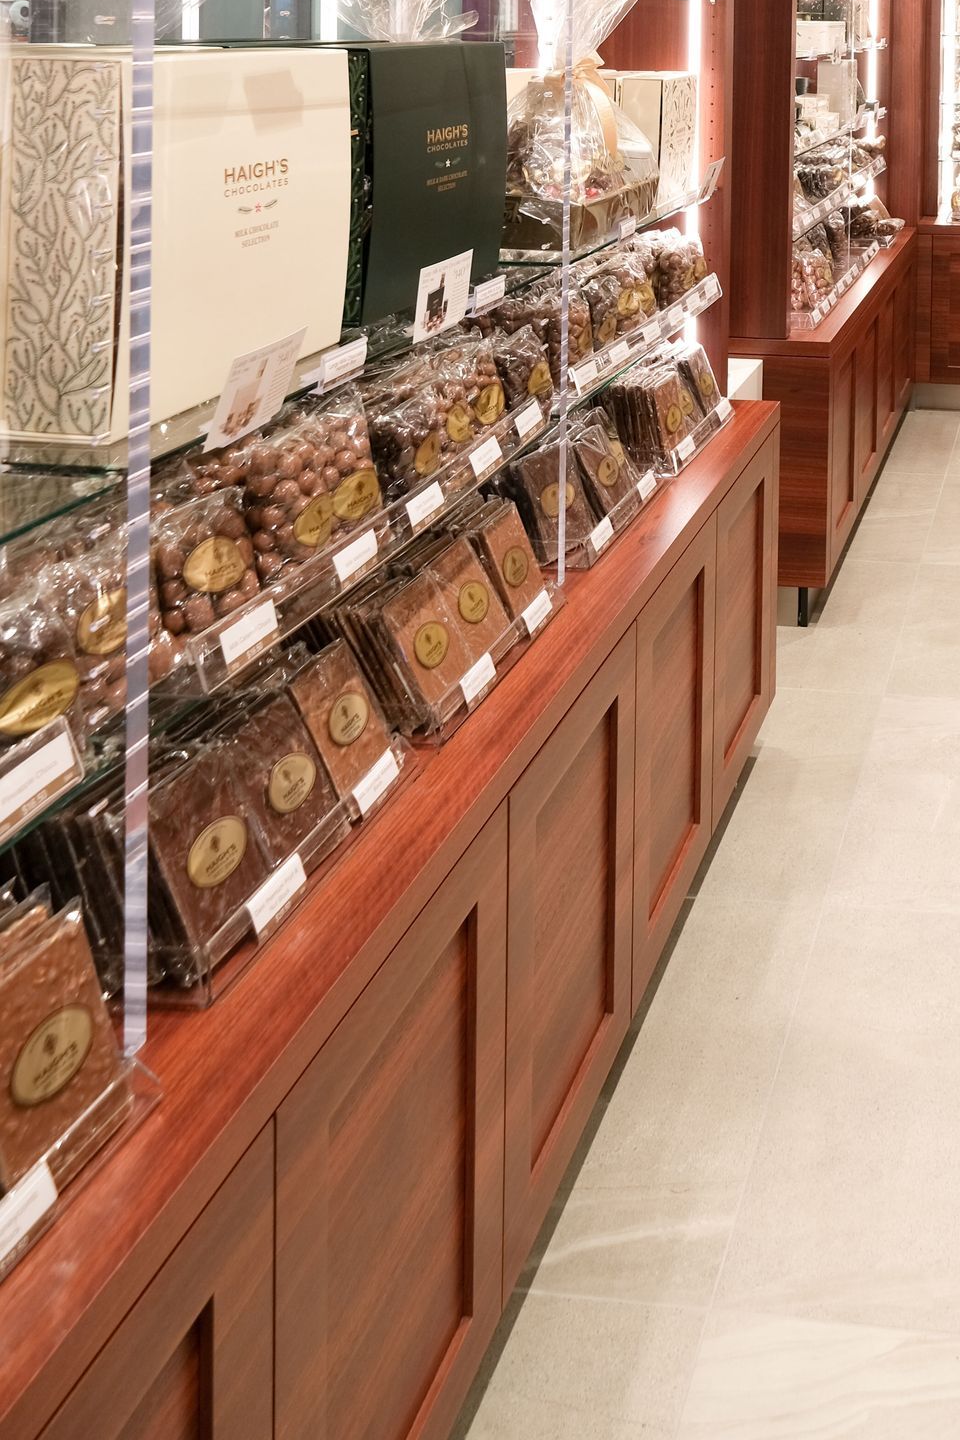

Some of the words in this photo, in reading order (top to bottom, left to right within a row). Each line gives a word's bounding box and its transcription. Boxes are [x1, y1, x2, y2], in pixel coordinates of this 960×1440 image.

[426, 124, 469, 144] HAIGH'S
[426, 139, 468, 153] CHOCOLATES
[223, 159, 289, 184] HAIGH'S
[223, 178, 289, 198] CHOCOLATES
